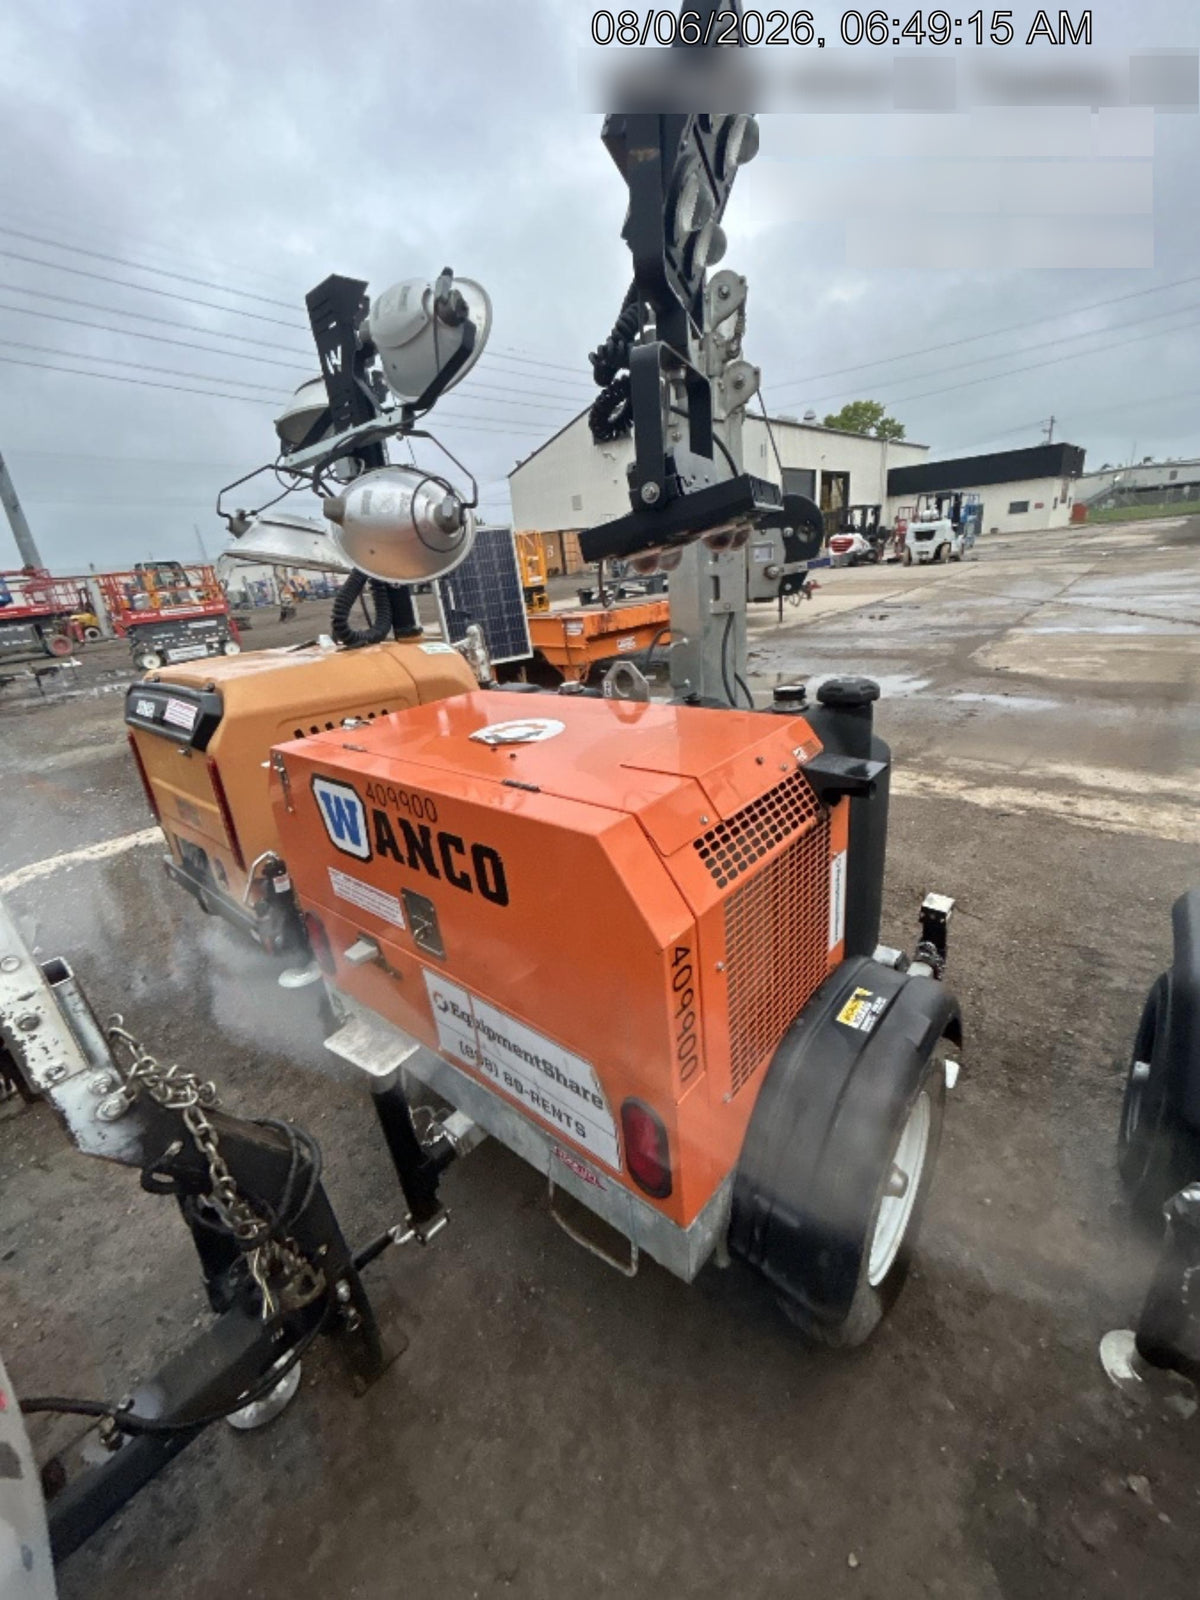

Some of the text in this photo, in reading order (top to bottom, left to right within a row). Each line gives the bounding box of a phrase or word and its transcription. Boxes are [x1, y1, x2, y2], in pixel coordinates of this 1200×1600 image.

[318, 788, 510, 908] WANCO
[365, 781, 438, 824] 409900
[670, 945, 700, 1083] 409900
